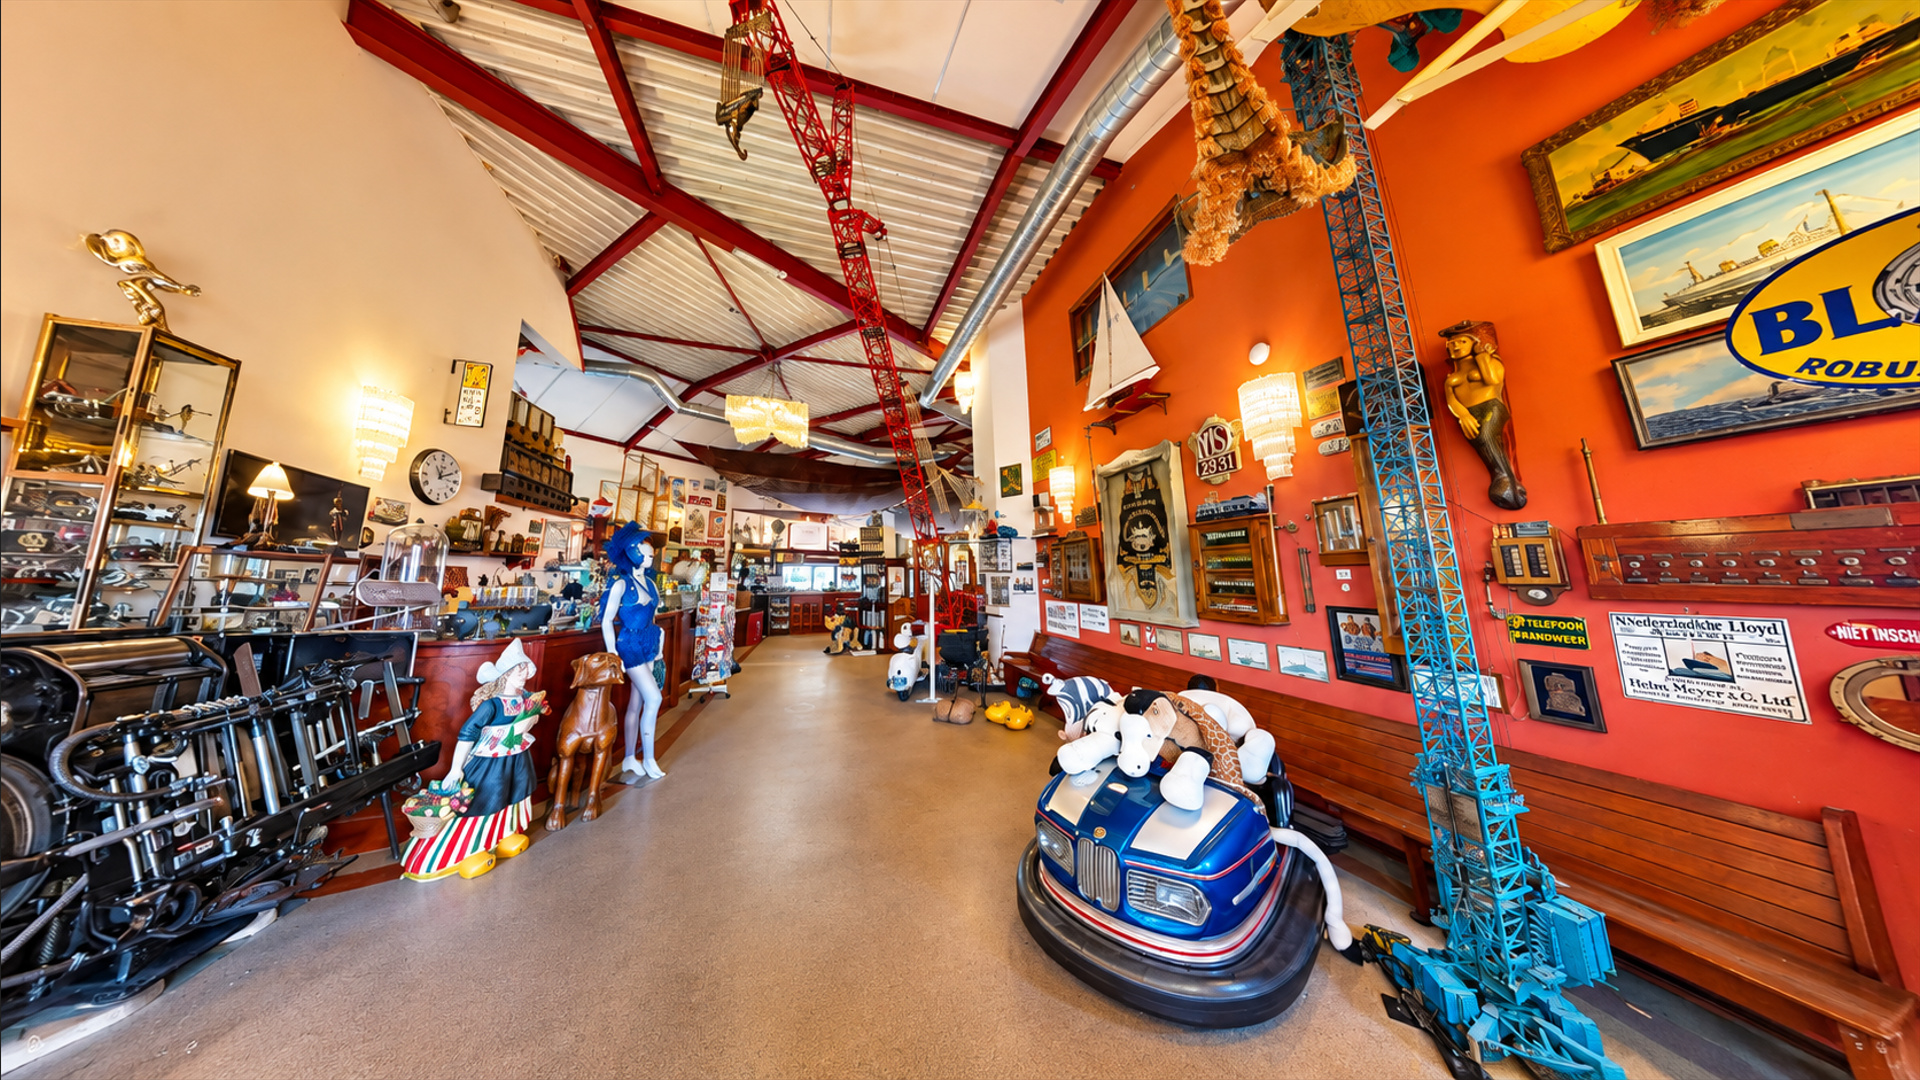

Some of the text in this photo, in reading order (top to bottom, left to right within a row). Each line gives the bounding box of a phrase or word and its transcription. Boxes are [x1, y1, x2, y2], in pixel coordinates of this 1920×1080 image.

[1748, 285, 1920, 356] BL
[1795, 357, 1920, 379] ROBU
[1201, 454, 1234, 476] 2931
[1729, 620, 1781, 637] Lloyd
[1836, 625, 1920, 644] NIET INSCH
[1673, 682, 1725, 698] Meyer
